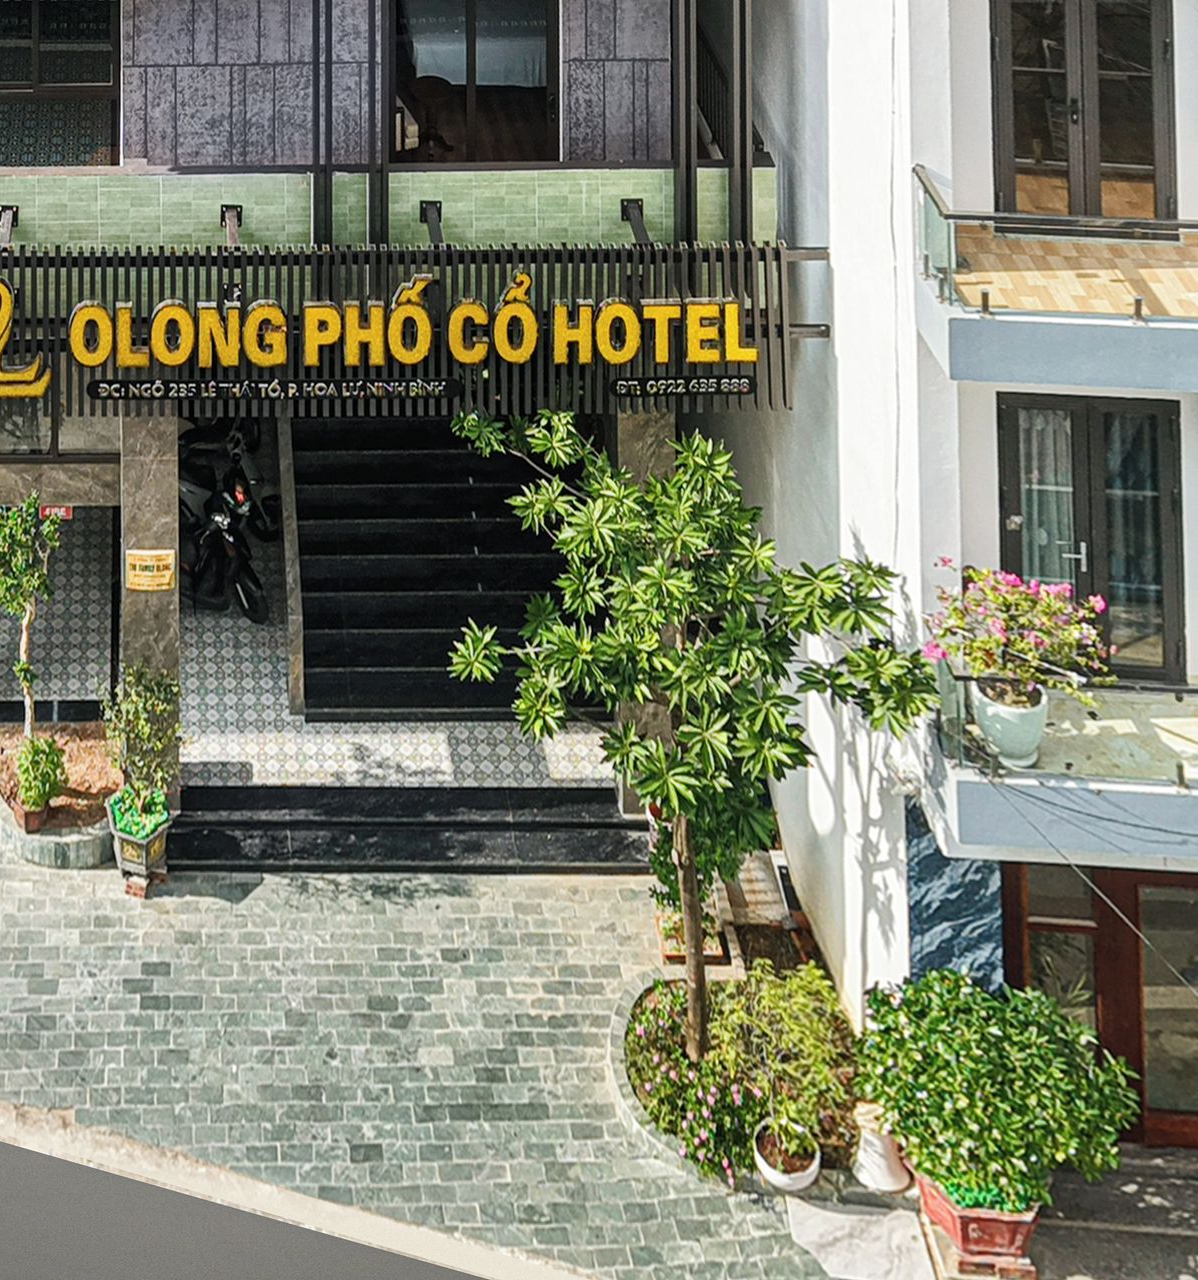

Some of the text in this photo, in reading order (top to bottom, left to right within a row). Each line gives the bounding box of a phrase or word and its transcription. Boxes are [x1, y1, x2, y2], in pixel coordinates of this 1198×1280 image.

[68, 269, 759, 368] OLONG PHỐ CỔ HOTEL
[303, 382, 339, 397] HOA
